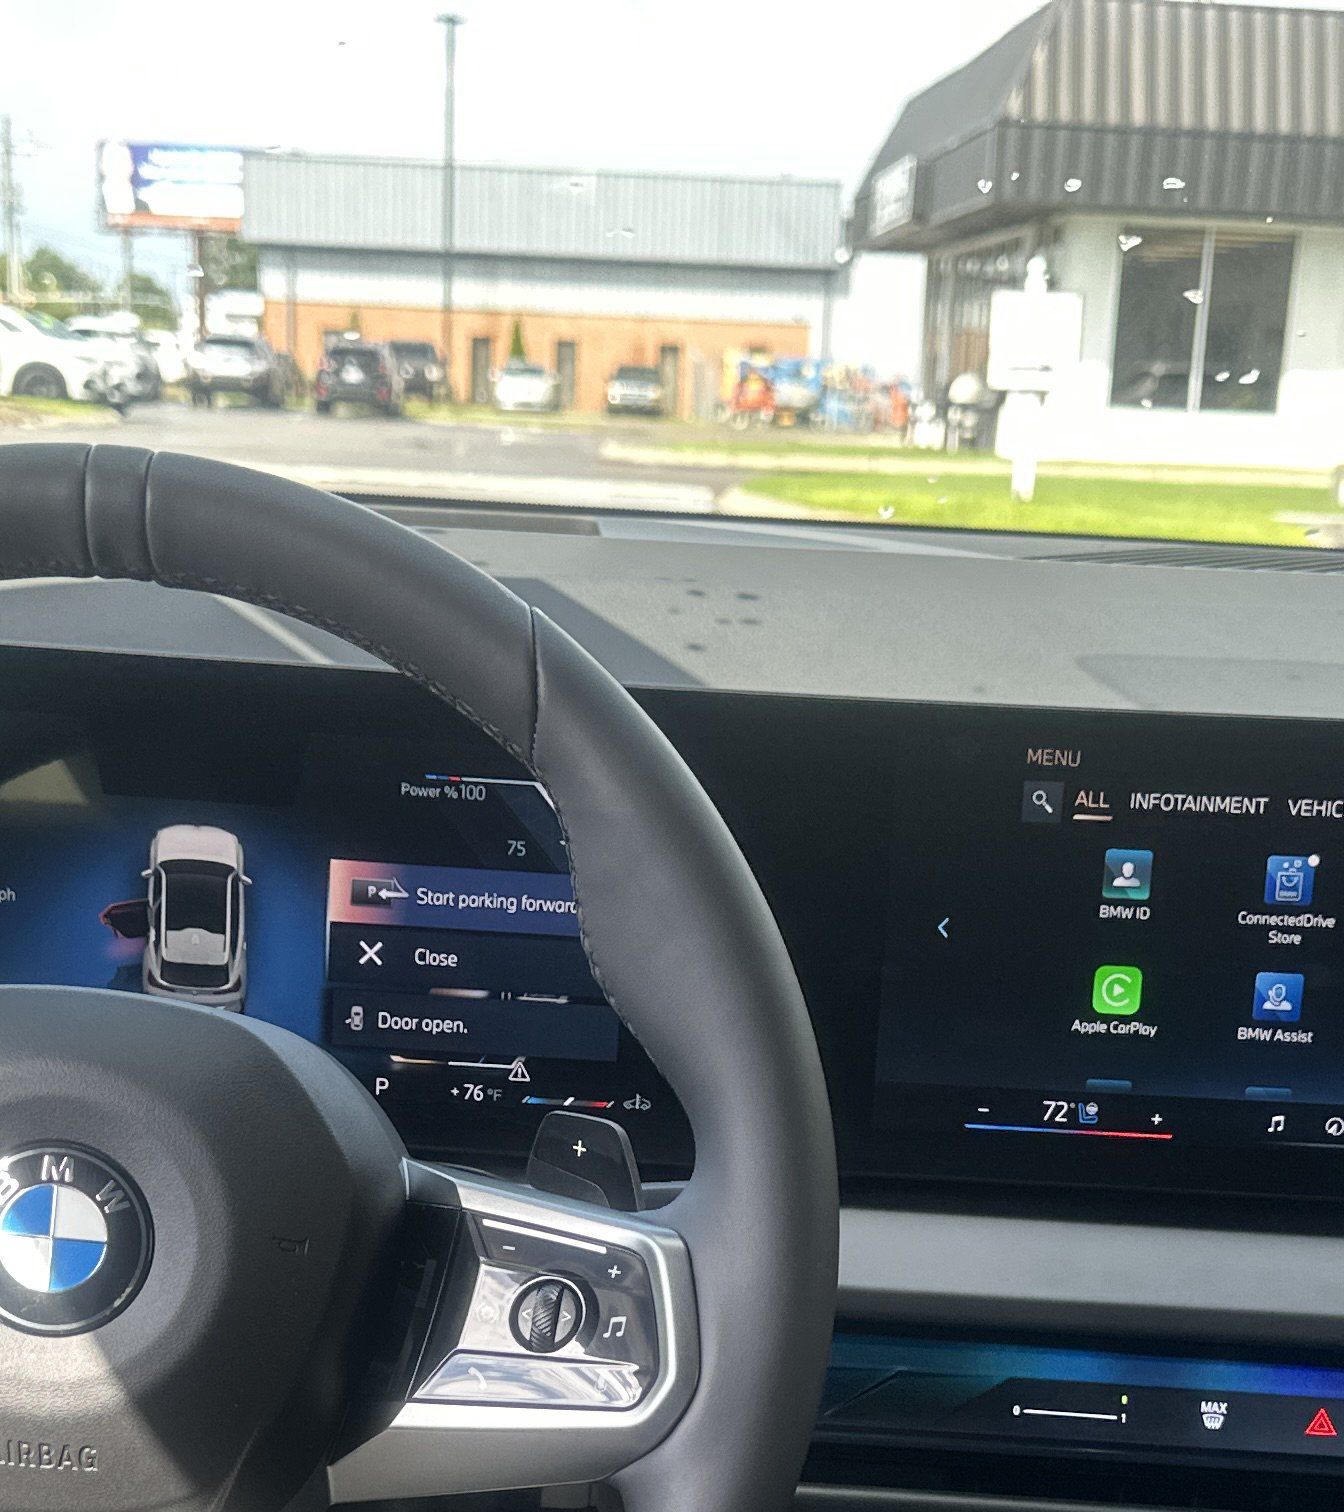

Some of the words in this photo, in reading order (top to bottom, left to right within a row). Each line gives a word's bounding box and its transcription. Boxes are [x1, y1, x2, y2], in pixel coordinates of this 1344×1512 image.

[1027, 748, 1081, 768] MENU
[401, 782, 441, 798] Power
[460, 783, 486, 801] 100
[1074, 790, 1110, 808] ALL
[1129, 792, 1270, 815] INFOTAINMENT
[507, 839, 526, 857] 75
[416, 887, 454, 907] Start
[458, 893, 518, 914] parking
[1098, 905, 1134, 919] BMW
[1135, 906, 1150, 921] ID
[1237, 910, 1336, 929] ConnectedDrive
[1268, 931, 1302, 946] Store
[414, 948, 458, 967] Close
[377, 1011, 419, 1030] Door
[421, 1017, 468, 1035] open.
[1071, 1018, 1108, 1035] Apple
[1109, 1020, 1158, 1037] CarPlay
[1237, 1026, 1272, 1042] BMW
[1274, 1028, 1313, 1044] Assist
[375, 1077, 389, 1095] P
[1200, 1400, 1228, 1414] MAX
